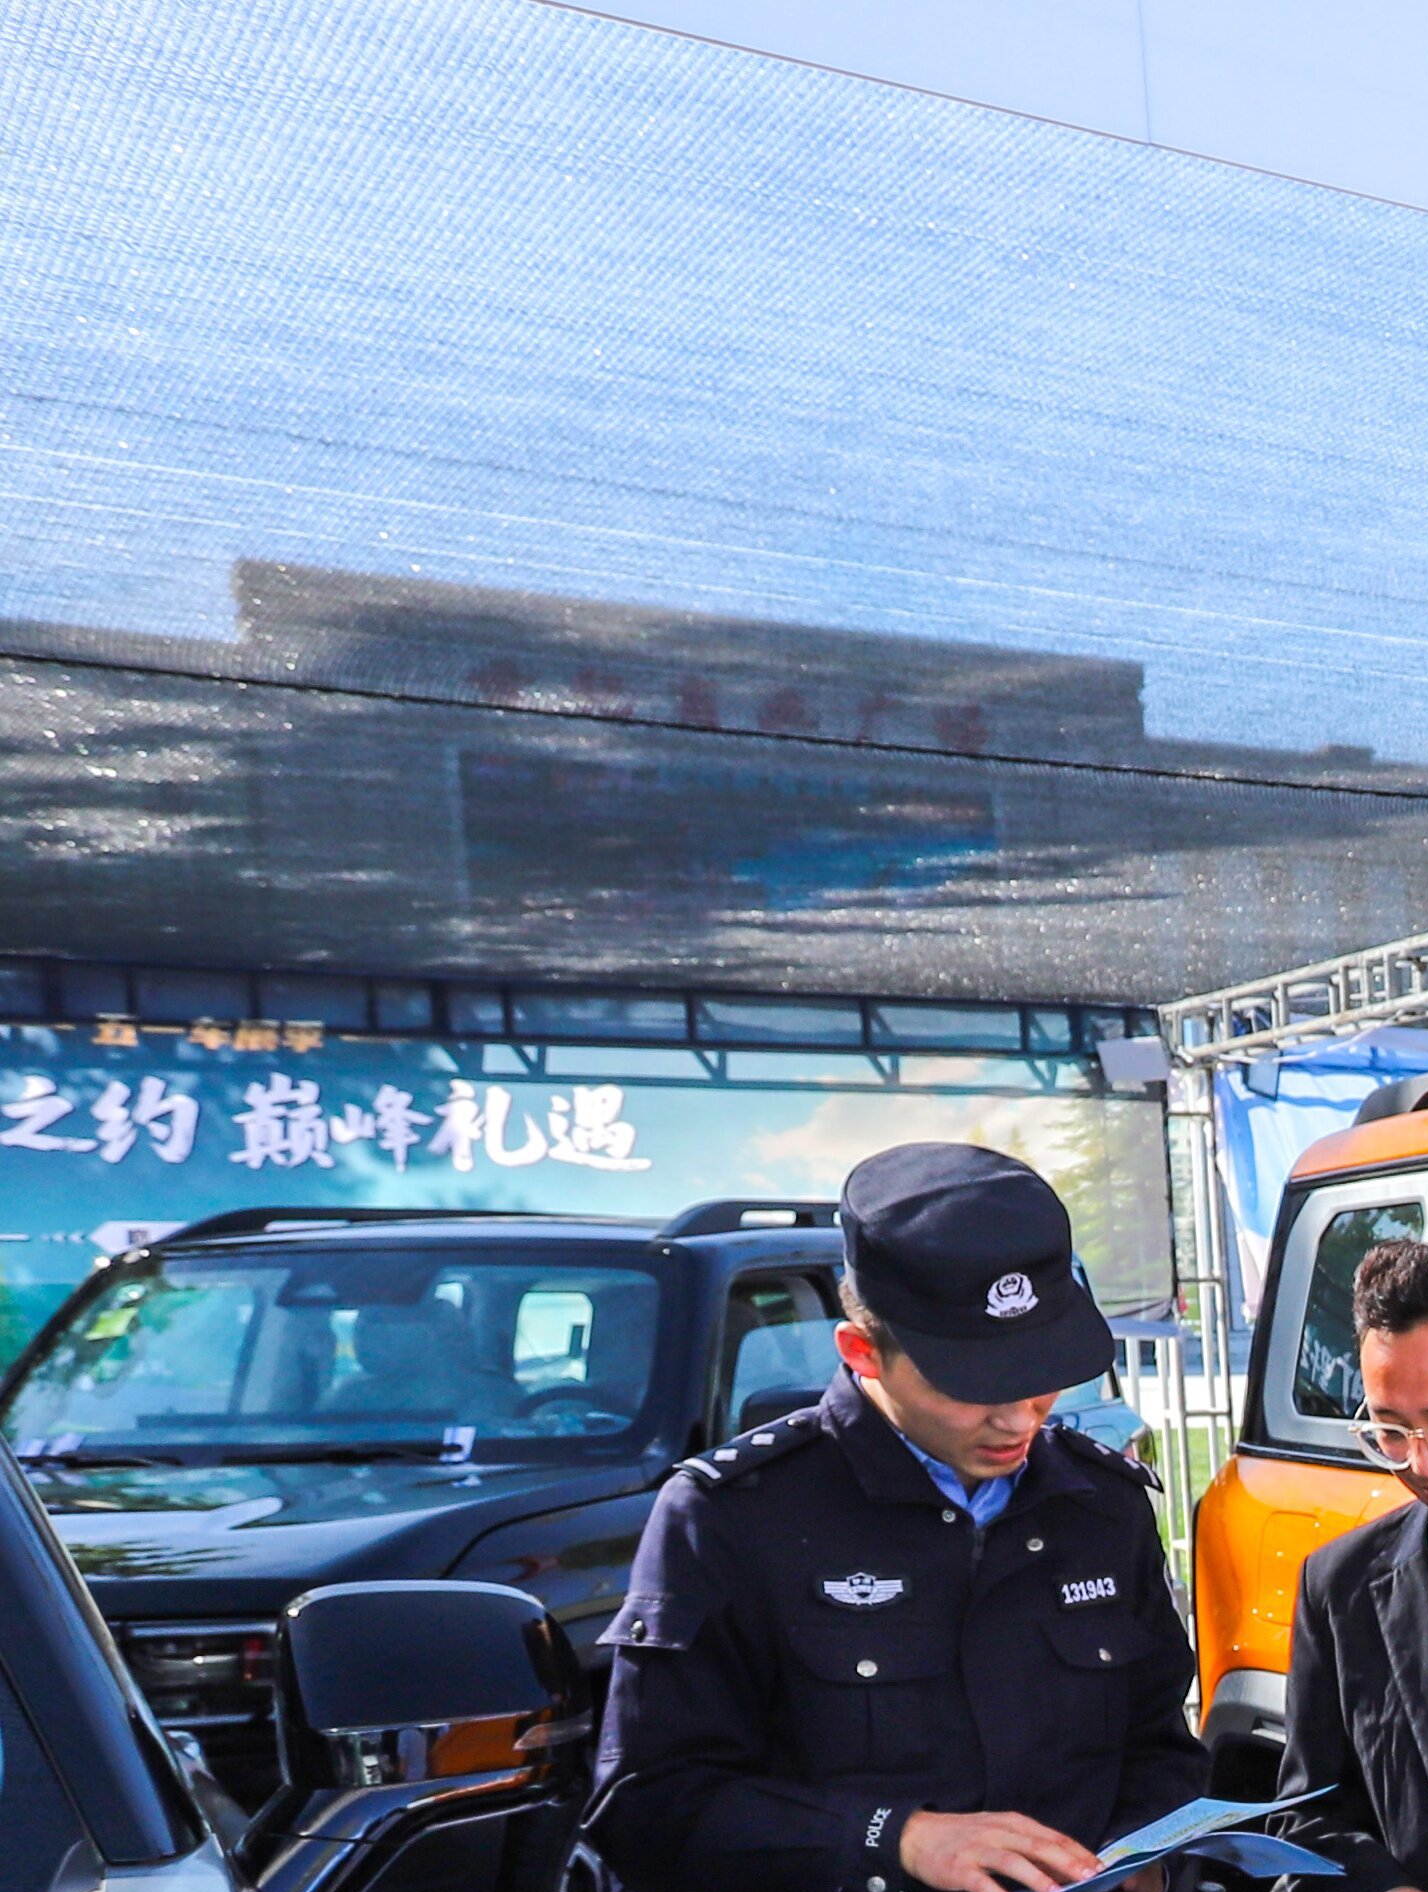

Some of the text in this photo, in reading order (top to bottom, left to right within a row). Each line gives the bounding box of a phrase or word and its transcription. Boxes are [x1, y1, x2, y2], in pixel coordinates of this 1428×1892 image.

[0, 1071, 652, 1173] 之约 巅峰礼遇
[1061, 1577, 1116, 1604] 131943
[865, 1808, 892, 1847] POLICE
